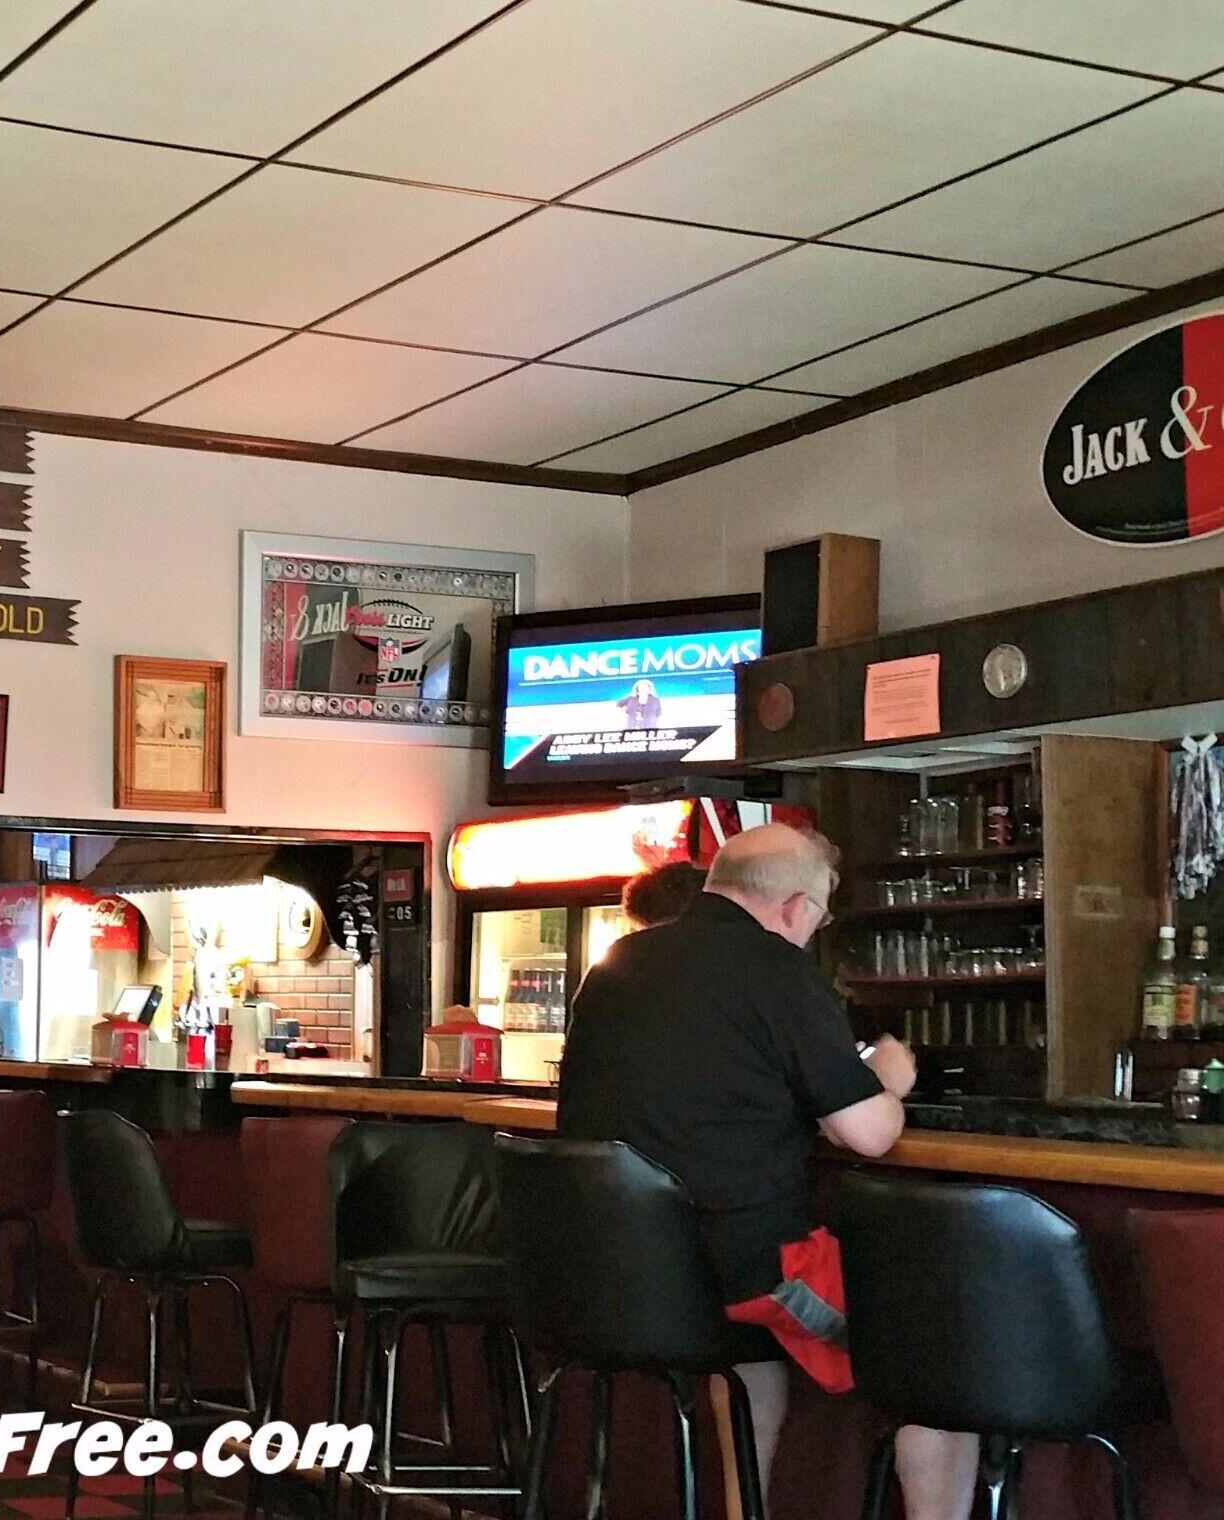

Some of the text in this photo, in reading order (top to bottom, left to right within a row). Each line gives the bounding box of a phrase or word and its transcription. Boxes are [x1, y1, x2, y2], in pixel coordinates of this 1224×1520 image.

[1063, 386, 1214, 485] JACK &
[387, 613, 434, 630] LIGHT
[524, 640, 758, 680] DANCE MOMS
